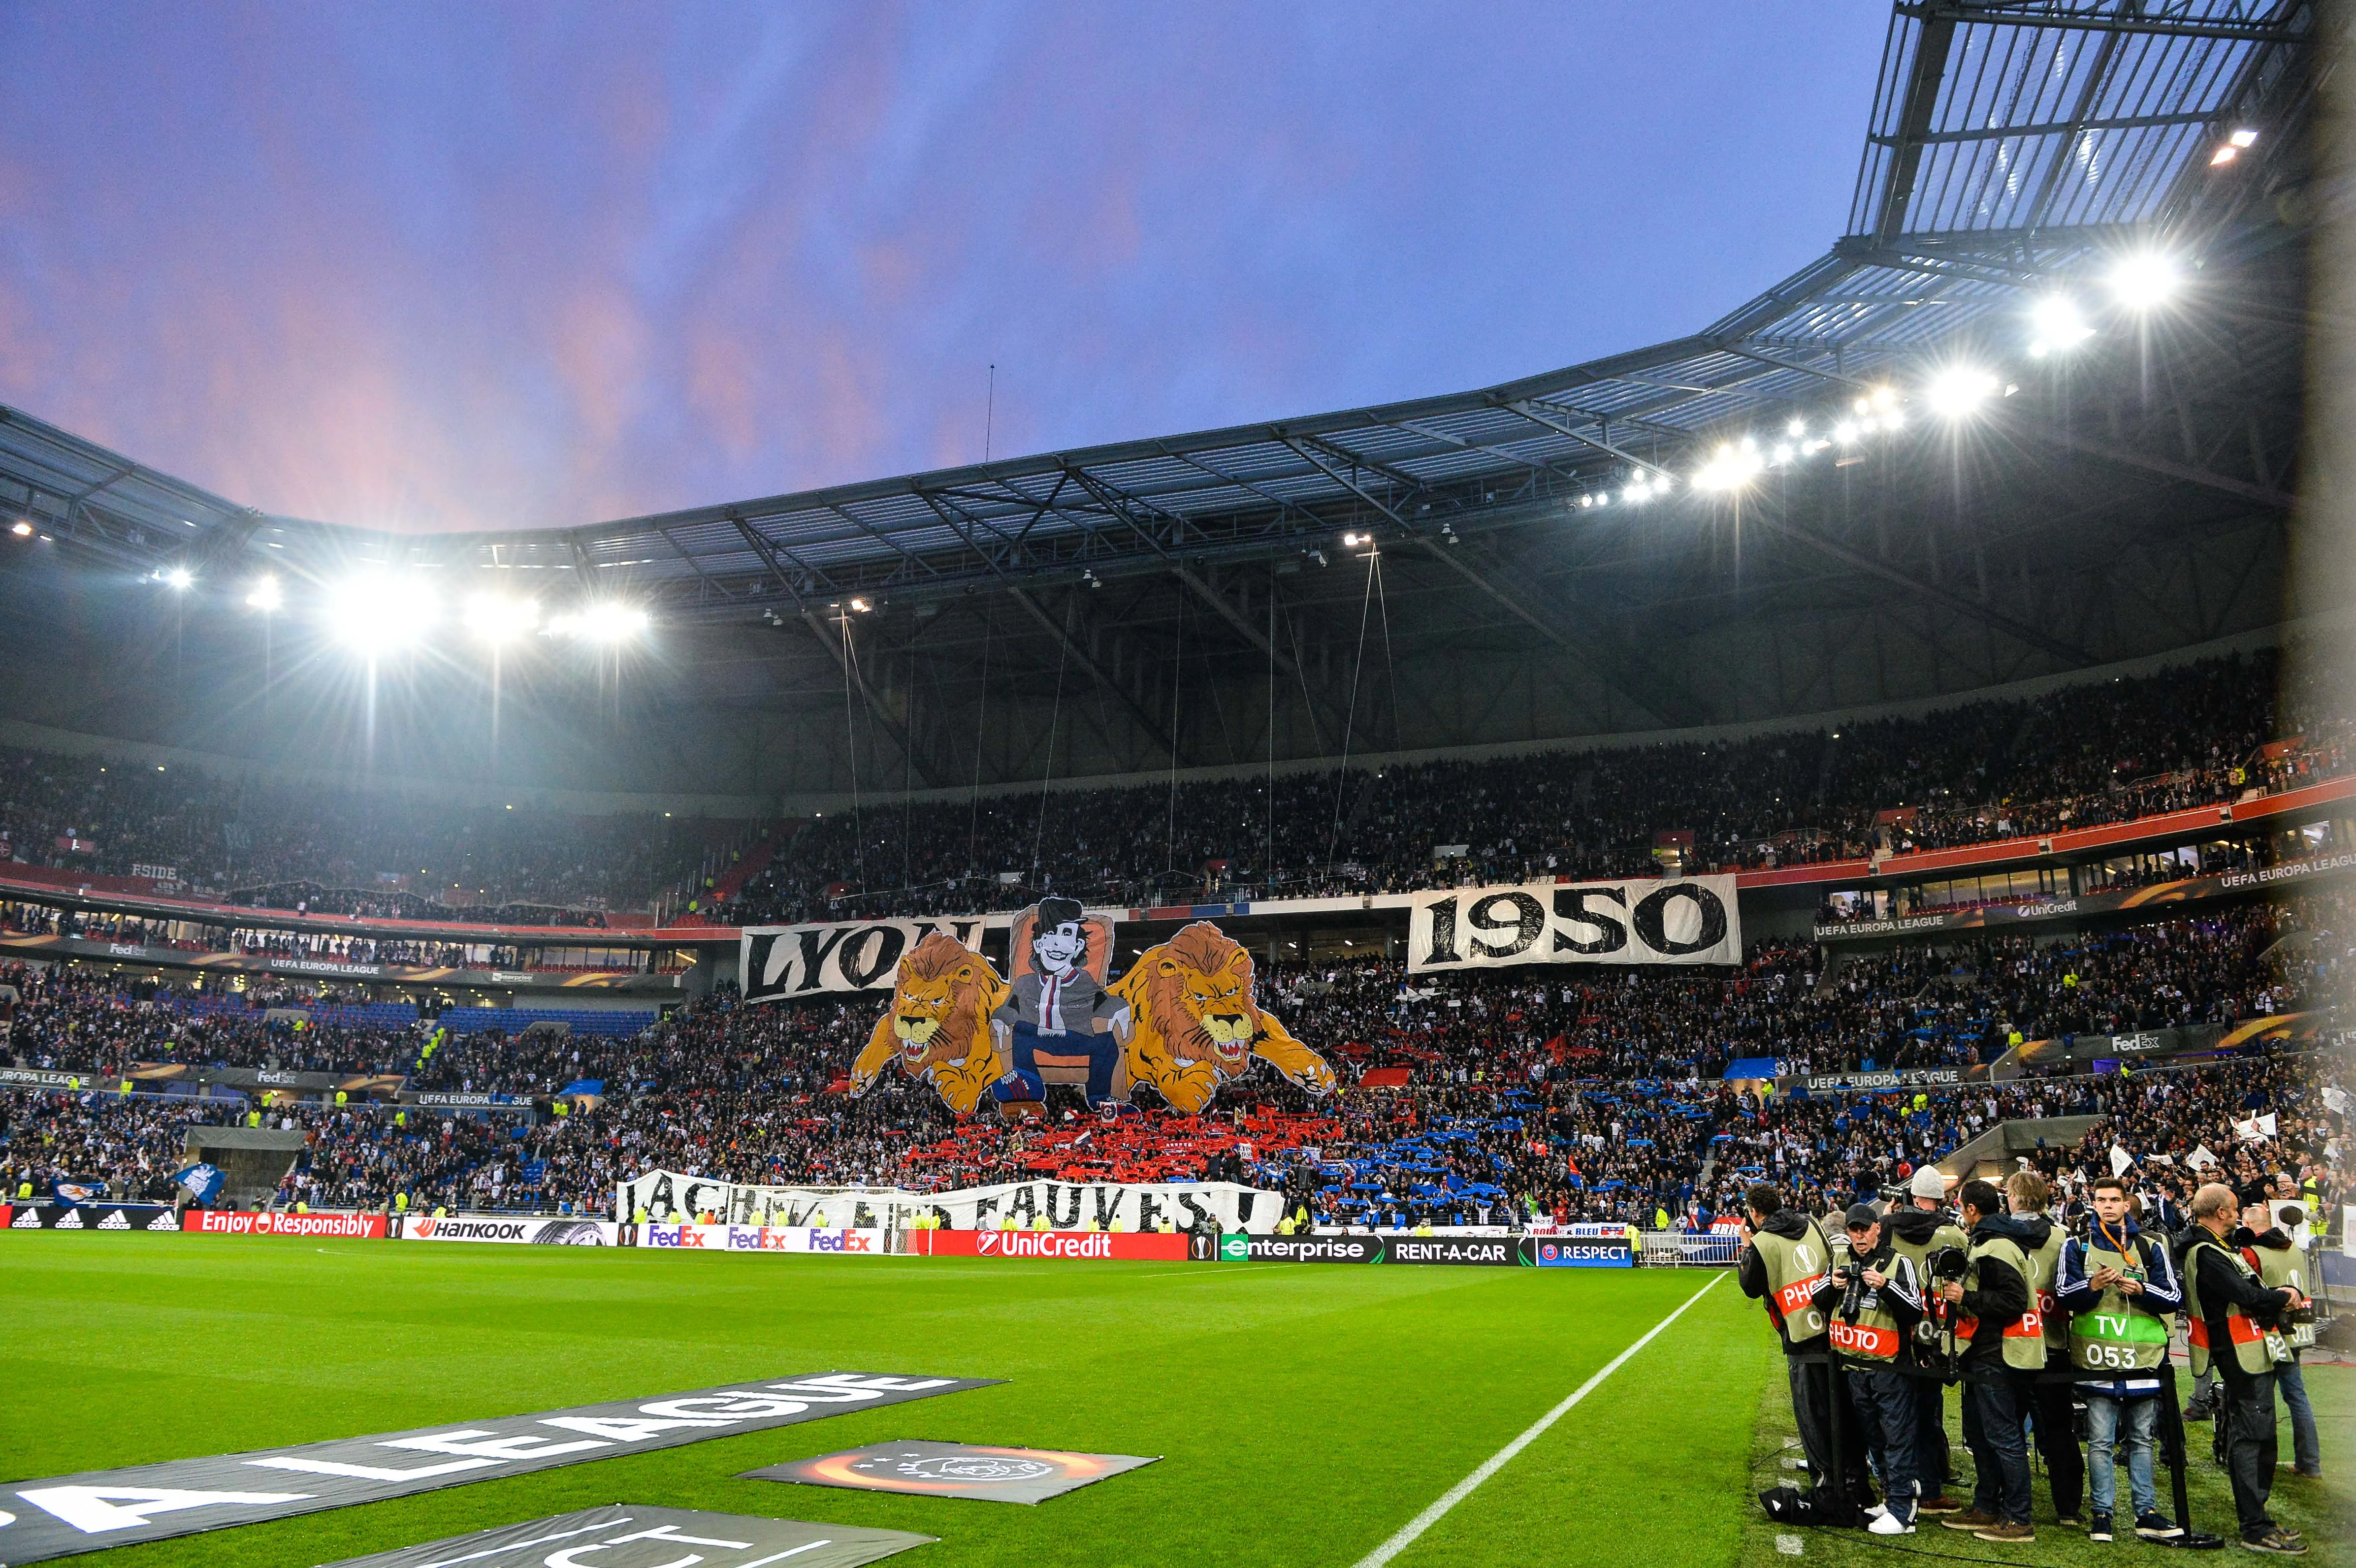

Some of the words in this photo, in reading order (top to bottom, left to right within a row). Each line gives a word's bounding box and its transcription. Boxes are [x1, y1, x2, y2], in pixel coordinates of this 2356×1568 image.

[2222, 873, 2258, 887] UEFA
[2259, 863, 2311, 882] EUROPA
[2031, 900, 2077, 915] UniCredit
[1422, 883, 1727, 965] 1950
[1817, 926, 1847, 936] UEFA
[1850, 922, 1896, 934] EUROPA
[1898, 916, 1944, 929] LEAGUE
[110, 943, 146, 956] FedEx
[271, 960, 297, 969] UEFA
[300, 961, 338, 972] EUROPA
[340, 965, 379, 974] LEAGUE
[2112, 1033, 2160, 1052] FedEx
[258, 1071, 295, 1084] FedEx
[450, 1095, 489, 1105] EUROPA
[55, 1221, 84, 1229] adidas
[97, 1221, 131, 1230] adidas
[202, 1211, 254, 1234] Enjoy
[274, 1213, 374, 1238] Responsibly
[648, 1225, 706, 1247] FedEx
[728, 1226, 786, 1249] FedEx
[809, 1228, 871, 1251] FedEx
[1001, 1232, 1111, 1258] UniCredit
[1225, 1238, 1364, 1261] enterprise
[1396, 1243, 1507, 1261] RENT-A-CAR
[1563, 1246, 1628, 1260] RESPECT
[2095, 1315, 2127, 1337] TV
[2086, 1344, 2136, 1370] 053
[240, 1374, 959, 1481] LEAGUE
